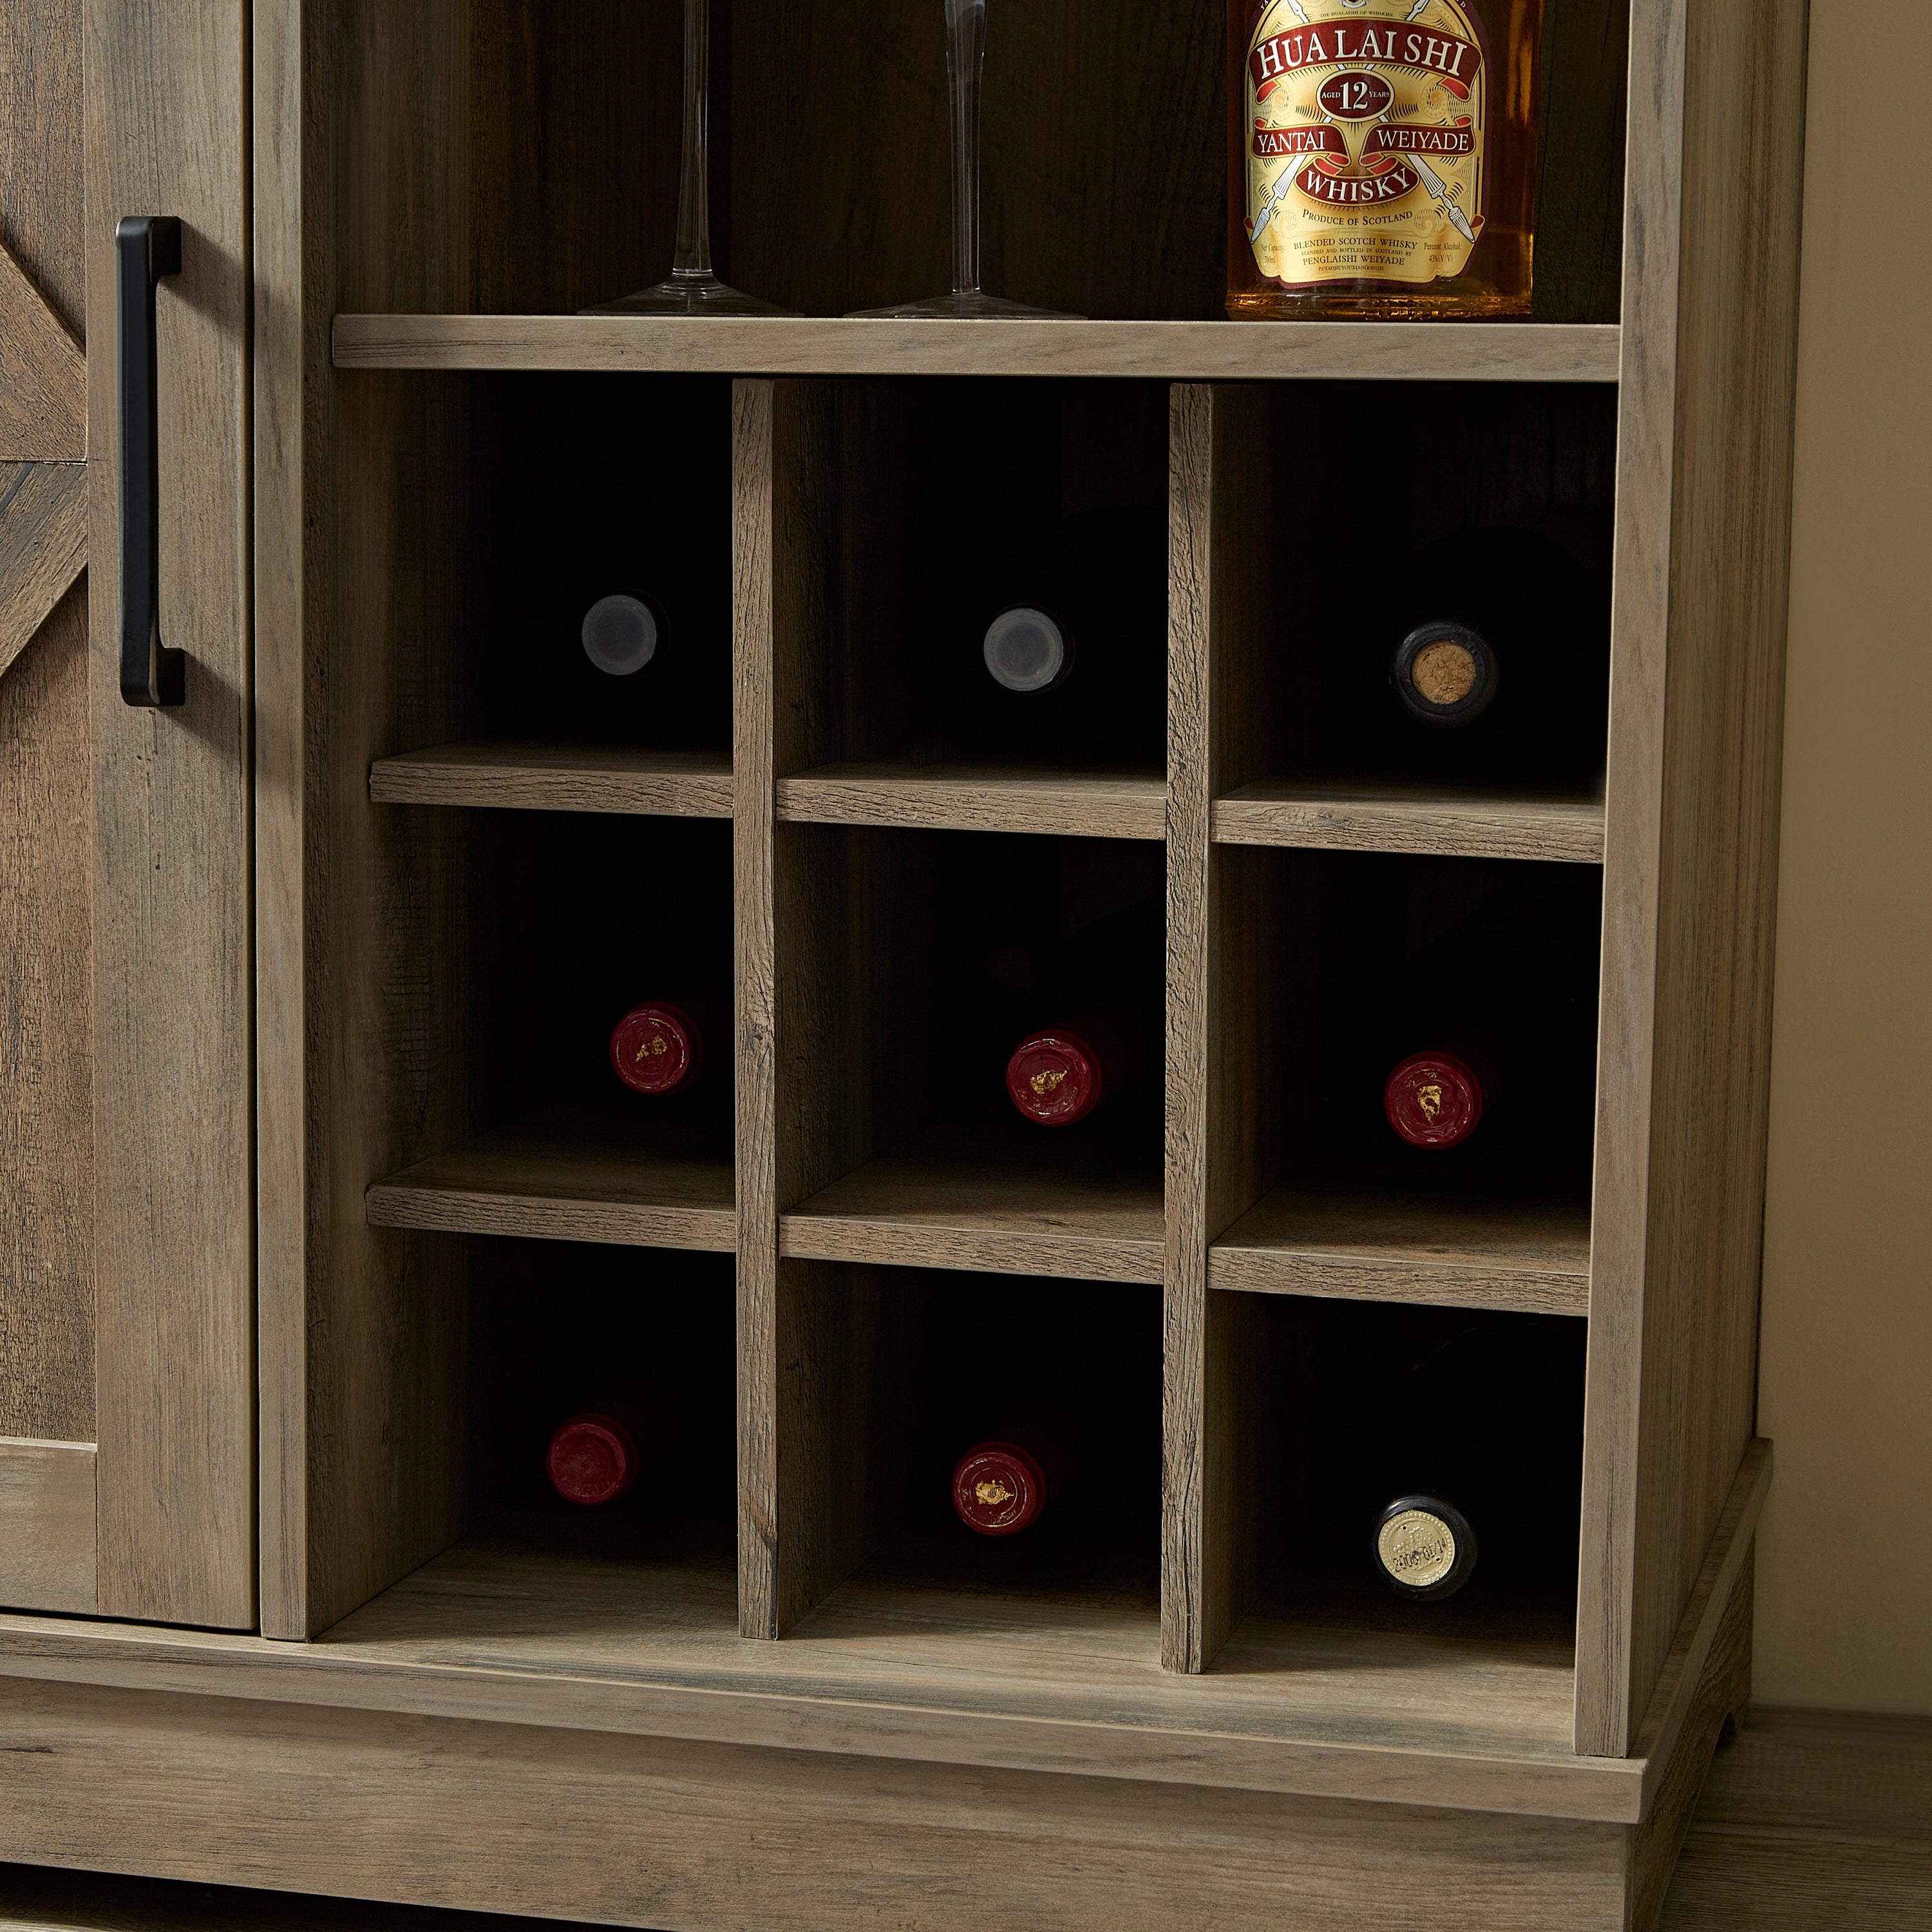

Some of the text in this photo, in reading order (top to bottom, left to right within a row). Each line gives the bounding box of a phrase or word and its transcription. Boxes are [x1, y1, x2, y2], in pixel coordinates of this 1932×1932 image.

[1257, 29, 1467, 79] HUA LAI SHI
[1340, 81, 1368, 109] 12
[1258, 131, 1325, 153] YANTAI
[1376, 129, 1469, 151] WEIYADE
[1307, 167, 1410, 202] WHISKY
[1302, 209, 1345, 225] PRODUCE
[1362, 211, 1413, 225] SCOTLAND
[1294, 237, 1418, 250] BLENDED SCOTCH WHISKY
[1424, 242, 1463, 251] Percent Alcohol:
[1303, 255, 1405, 266] PENGLAISHI WEIYADE
